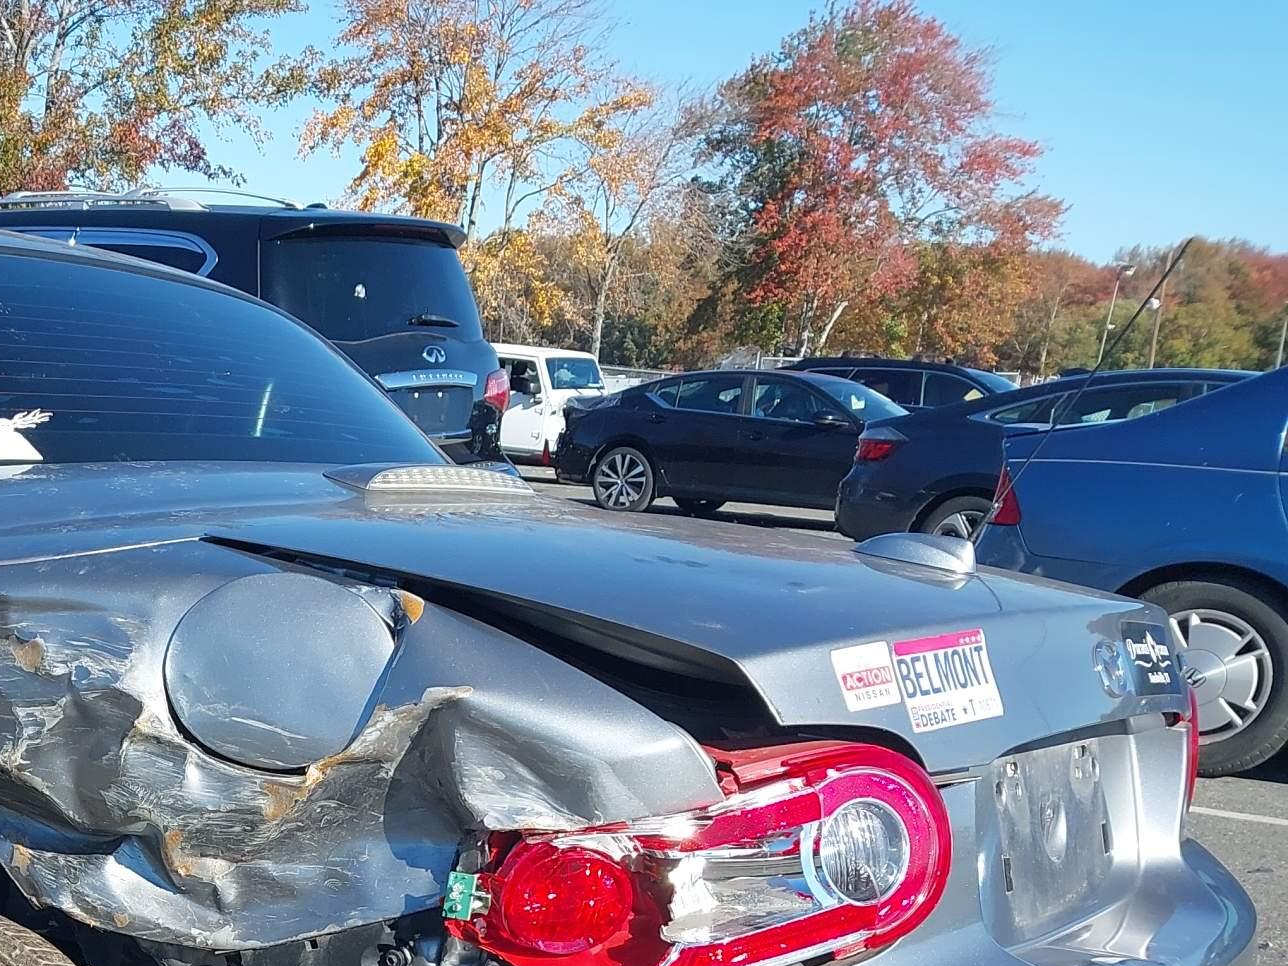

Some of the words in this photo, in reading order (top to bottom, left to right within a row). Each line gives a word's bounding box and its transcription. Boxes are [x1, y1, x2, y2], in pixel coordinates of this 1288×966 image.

[845, 667, 892, 688] ACTION
[896, 645, 990, 699] BELMONT
[855, 688, 891, 702] NISSAN
[920, 708, 957, 727] DEBATE
